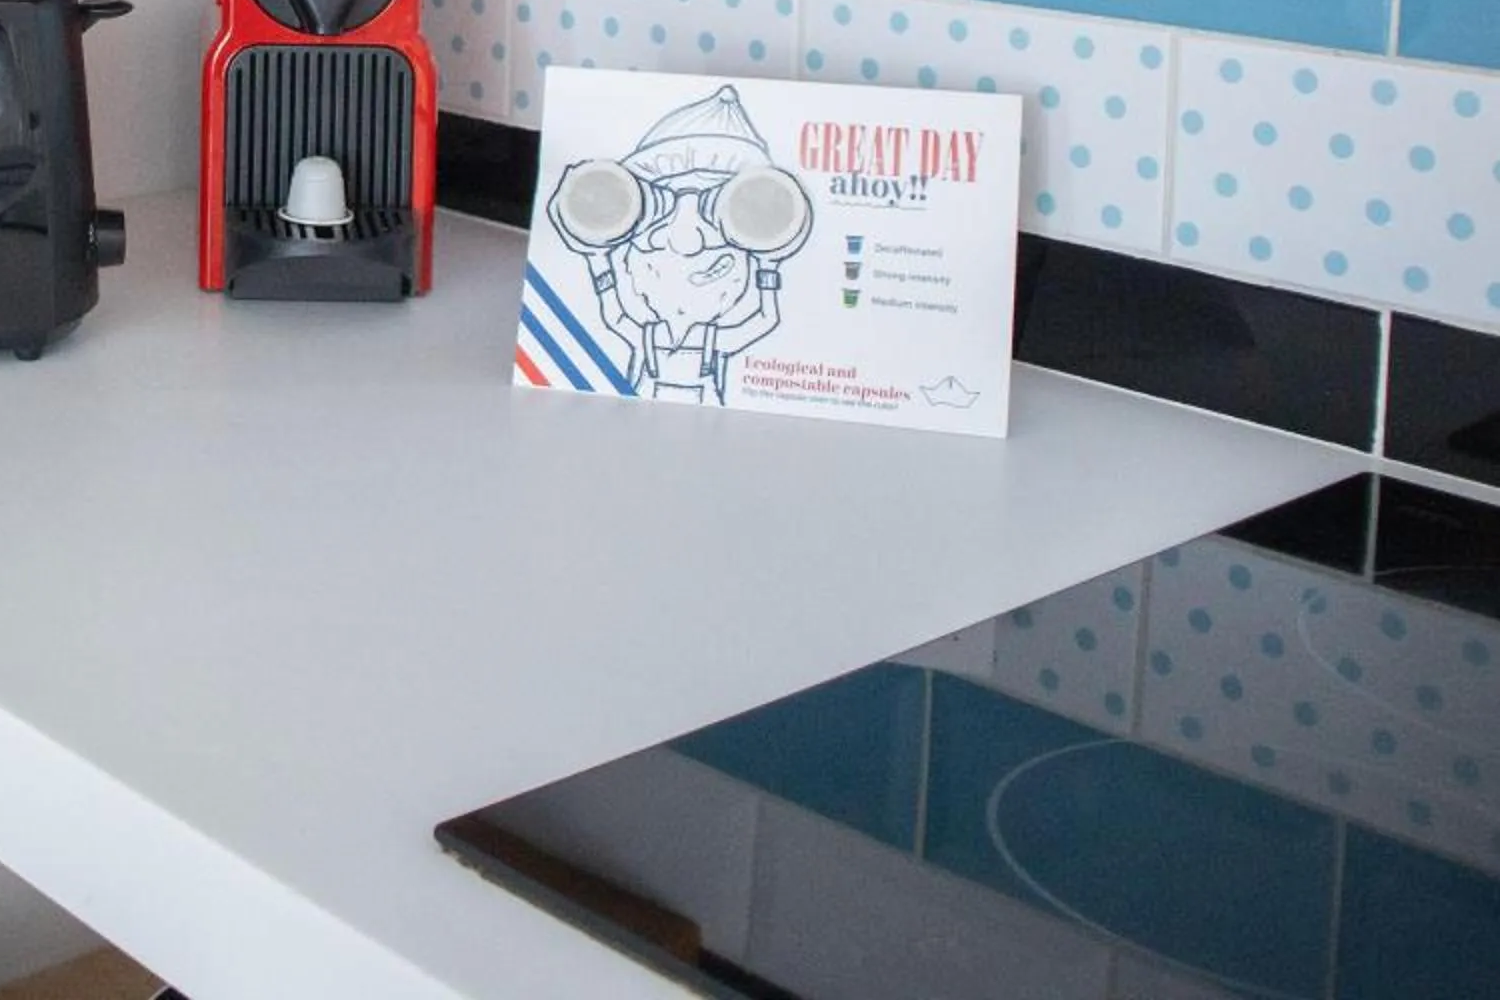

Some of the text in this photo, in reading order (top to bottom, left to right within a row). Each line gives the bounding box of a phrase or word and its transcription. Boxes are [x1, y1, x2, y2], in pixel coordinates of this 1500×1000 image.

[799, 121, 985, 183] GREAT DAY
[829, 170, 928, 206] ahoy!!
[743, 355, 857, 379] Ecological and
[742, 374, 912, 401] compostable capsules
